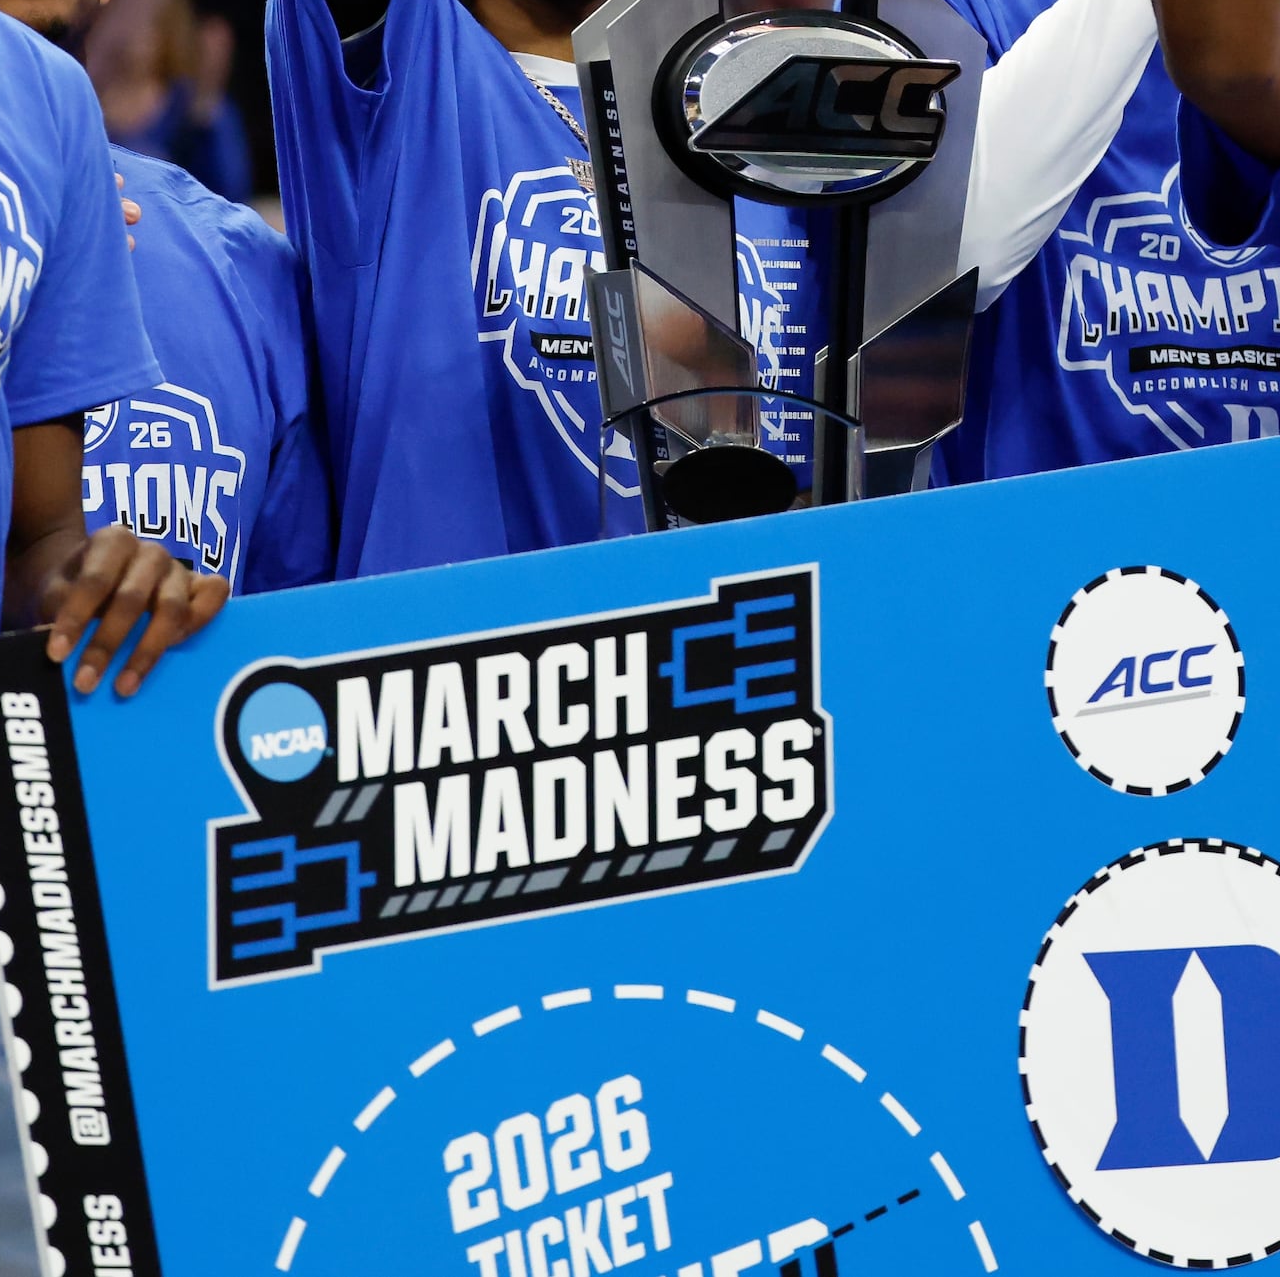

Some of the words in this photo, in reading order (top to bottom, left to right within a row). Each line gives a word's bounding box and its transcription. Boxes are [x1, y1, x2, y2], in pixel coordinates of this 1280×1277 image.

[705, 59, 960, 137] ACC
[603, 89, 638, 251] GREATNESS
[559, 206, 602, 237] 20
[761, 260, 802, 269] CALIFORNIA
[1138, 232, 1181, 262] 20
[605, 285, 633, 392] ACC
[786, 325, 807, 334] STATE
[788, 347, 806, 356] TECH
[1150, 349, 1211, 365] MEN'S
[1132, 377, 1249, 394] ACCOMPLISH
[128, 421, 172, 449] 26
[1086, 643, 1219, 705] ACC
[336, 631, 649, 783] MARCH
[250, 724, 326, 761] NCAA
[392, 717, 817, 888] MADNESS
[0, 691, 112, 1148] @MARCHMADNESSMBB
[442, 1074, 651, 1235] 2026
[466, 1171, 674, 1277] TICKET
